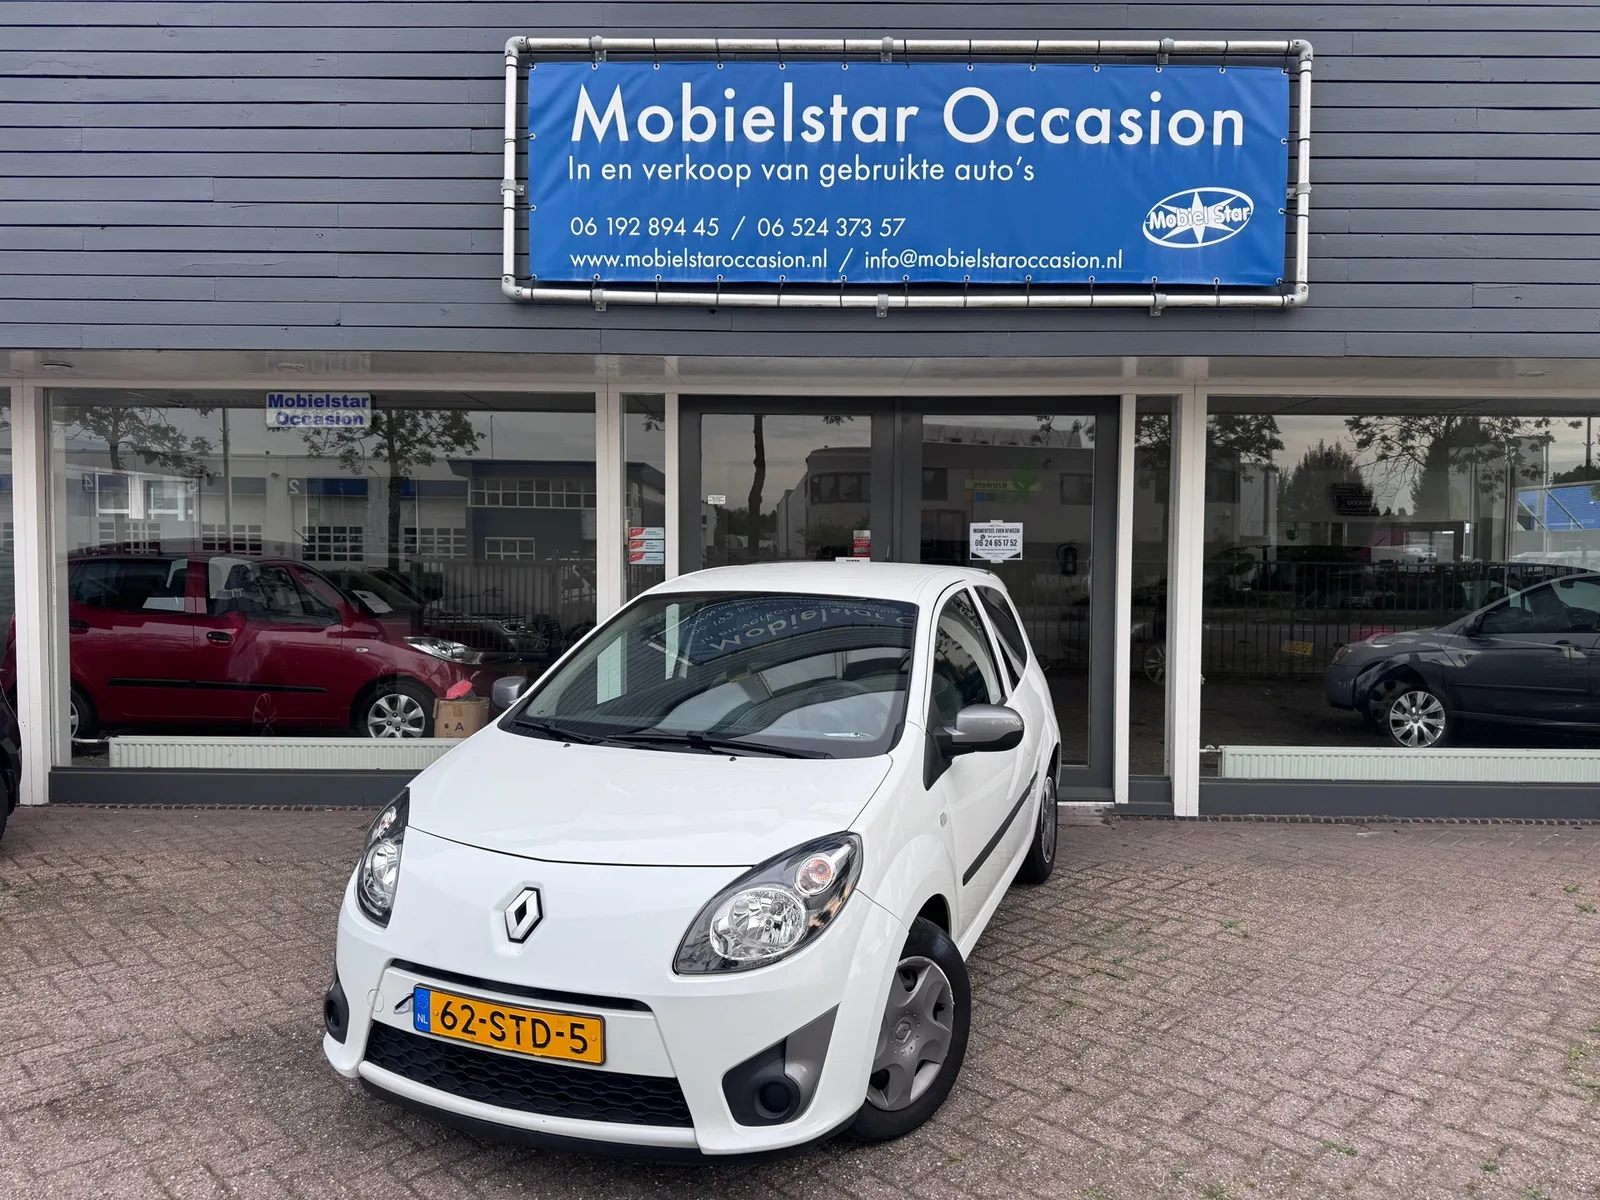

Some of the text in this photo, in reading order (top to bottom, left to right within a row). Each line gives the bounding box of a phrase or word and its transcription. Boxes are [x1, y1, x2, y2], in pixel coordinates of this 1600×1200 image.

[571, 81, 1244, 147] Mobielstar Occasion
[568, 155, 591, 180] In
[601, 163, 632, 181] en
[642, 153, 752, 188] verkoop
[761, 163, 809, 181] van
[819, 153, 945, 188] gebruikte
[570, 216, 598, 236] 06
[606, 216, 641, 236] 192
[648, 217, 687, 237] 894
[692, 217, 719, 237] 45
[757, 217, 785, 237] 06
[790, 217, 829, 237] 524
[835, 217, 872, 238] 373
[879, 217, 907, 237] 57
[1149, 204, 1251, 231] Mobiel Star
[569, 247, 827, 269] www.mobielstaroccasion.nl
[865, 247, 1123, 270] info@mobielstaroccasion.nl
[267, 393, 370, 408] Mobielstar
[275, 411, 365, 426] Occasion
[984, 539, 993, 547] 24
[994, 539, 1002, 547] 65
[1003, 539, 1009, 547] 17
[1009, 539, 1018, 547] 52
[417, 1012, 429, 1025] NL
[440, 1000, 588, 1055] 62-STD-5
